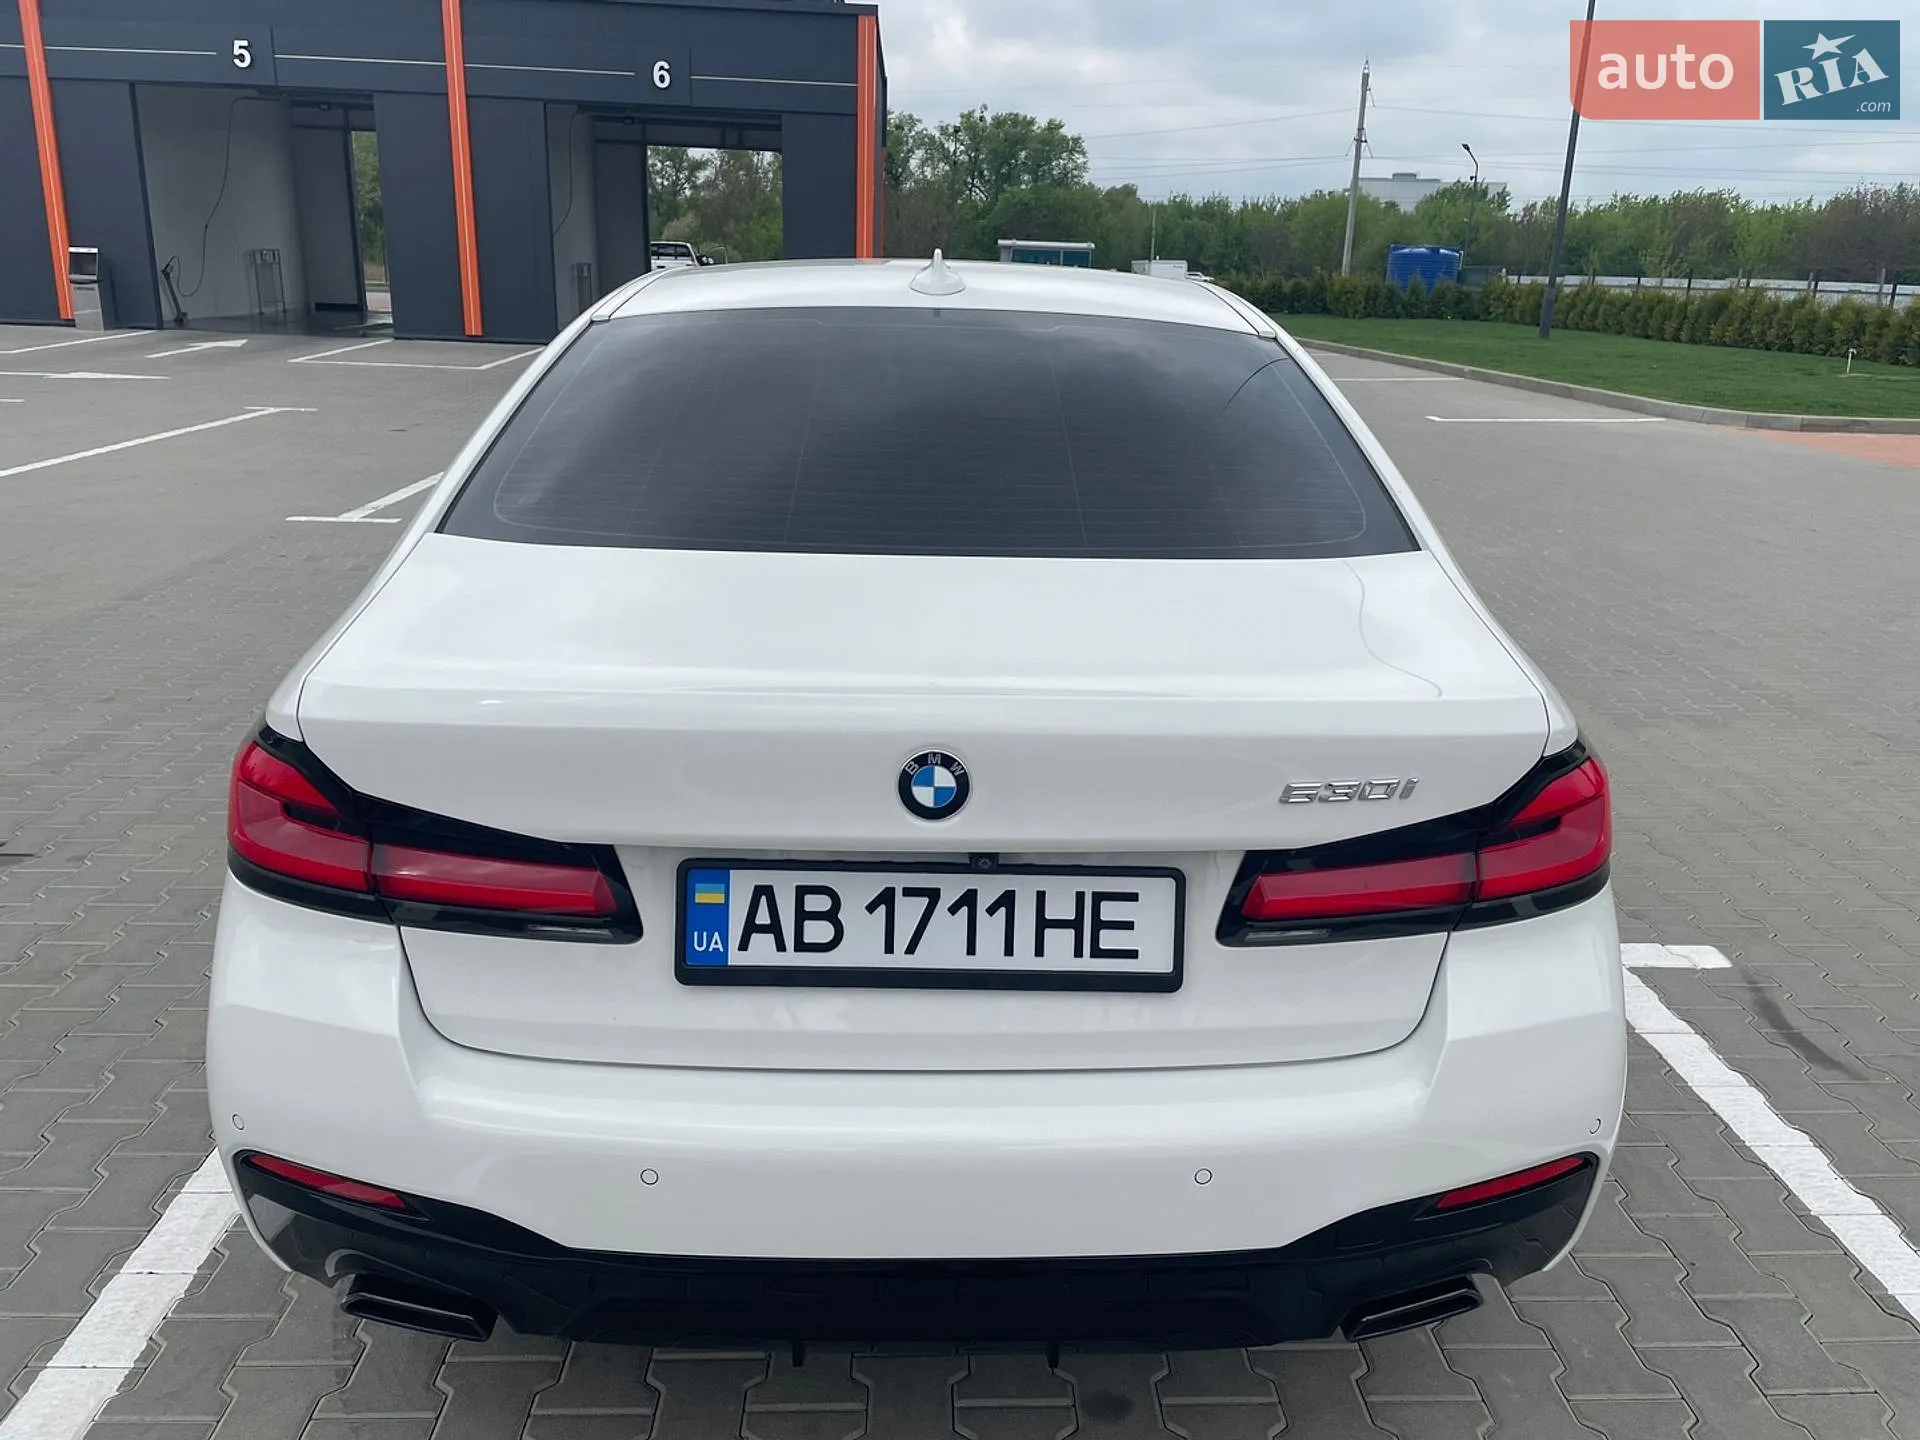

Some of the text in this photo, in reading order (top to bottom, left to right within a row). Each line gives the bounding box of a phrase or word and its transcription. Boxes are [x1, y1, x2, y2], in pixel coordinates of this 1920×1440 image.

[233, 40, 251, 68] 5
[653, 60, 670, 88] 6
[904, 753, 965, 776] BMW
[737, 884, 1139, 960] AB 1711 HE
[693, 931, 724, 952] UA
